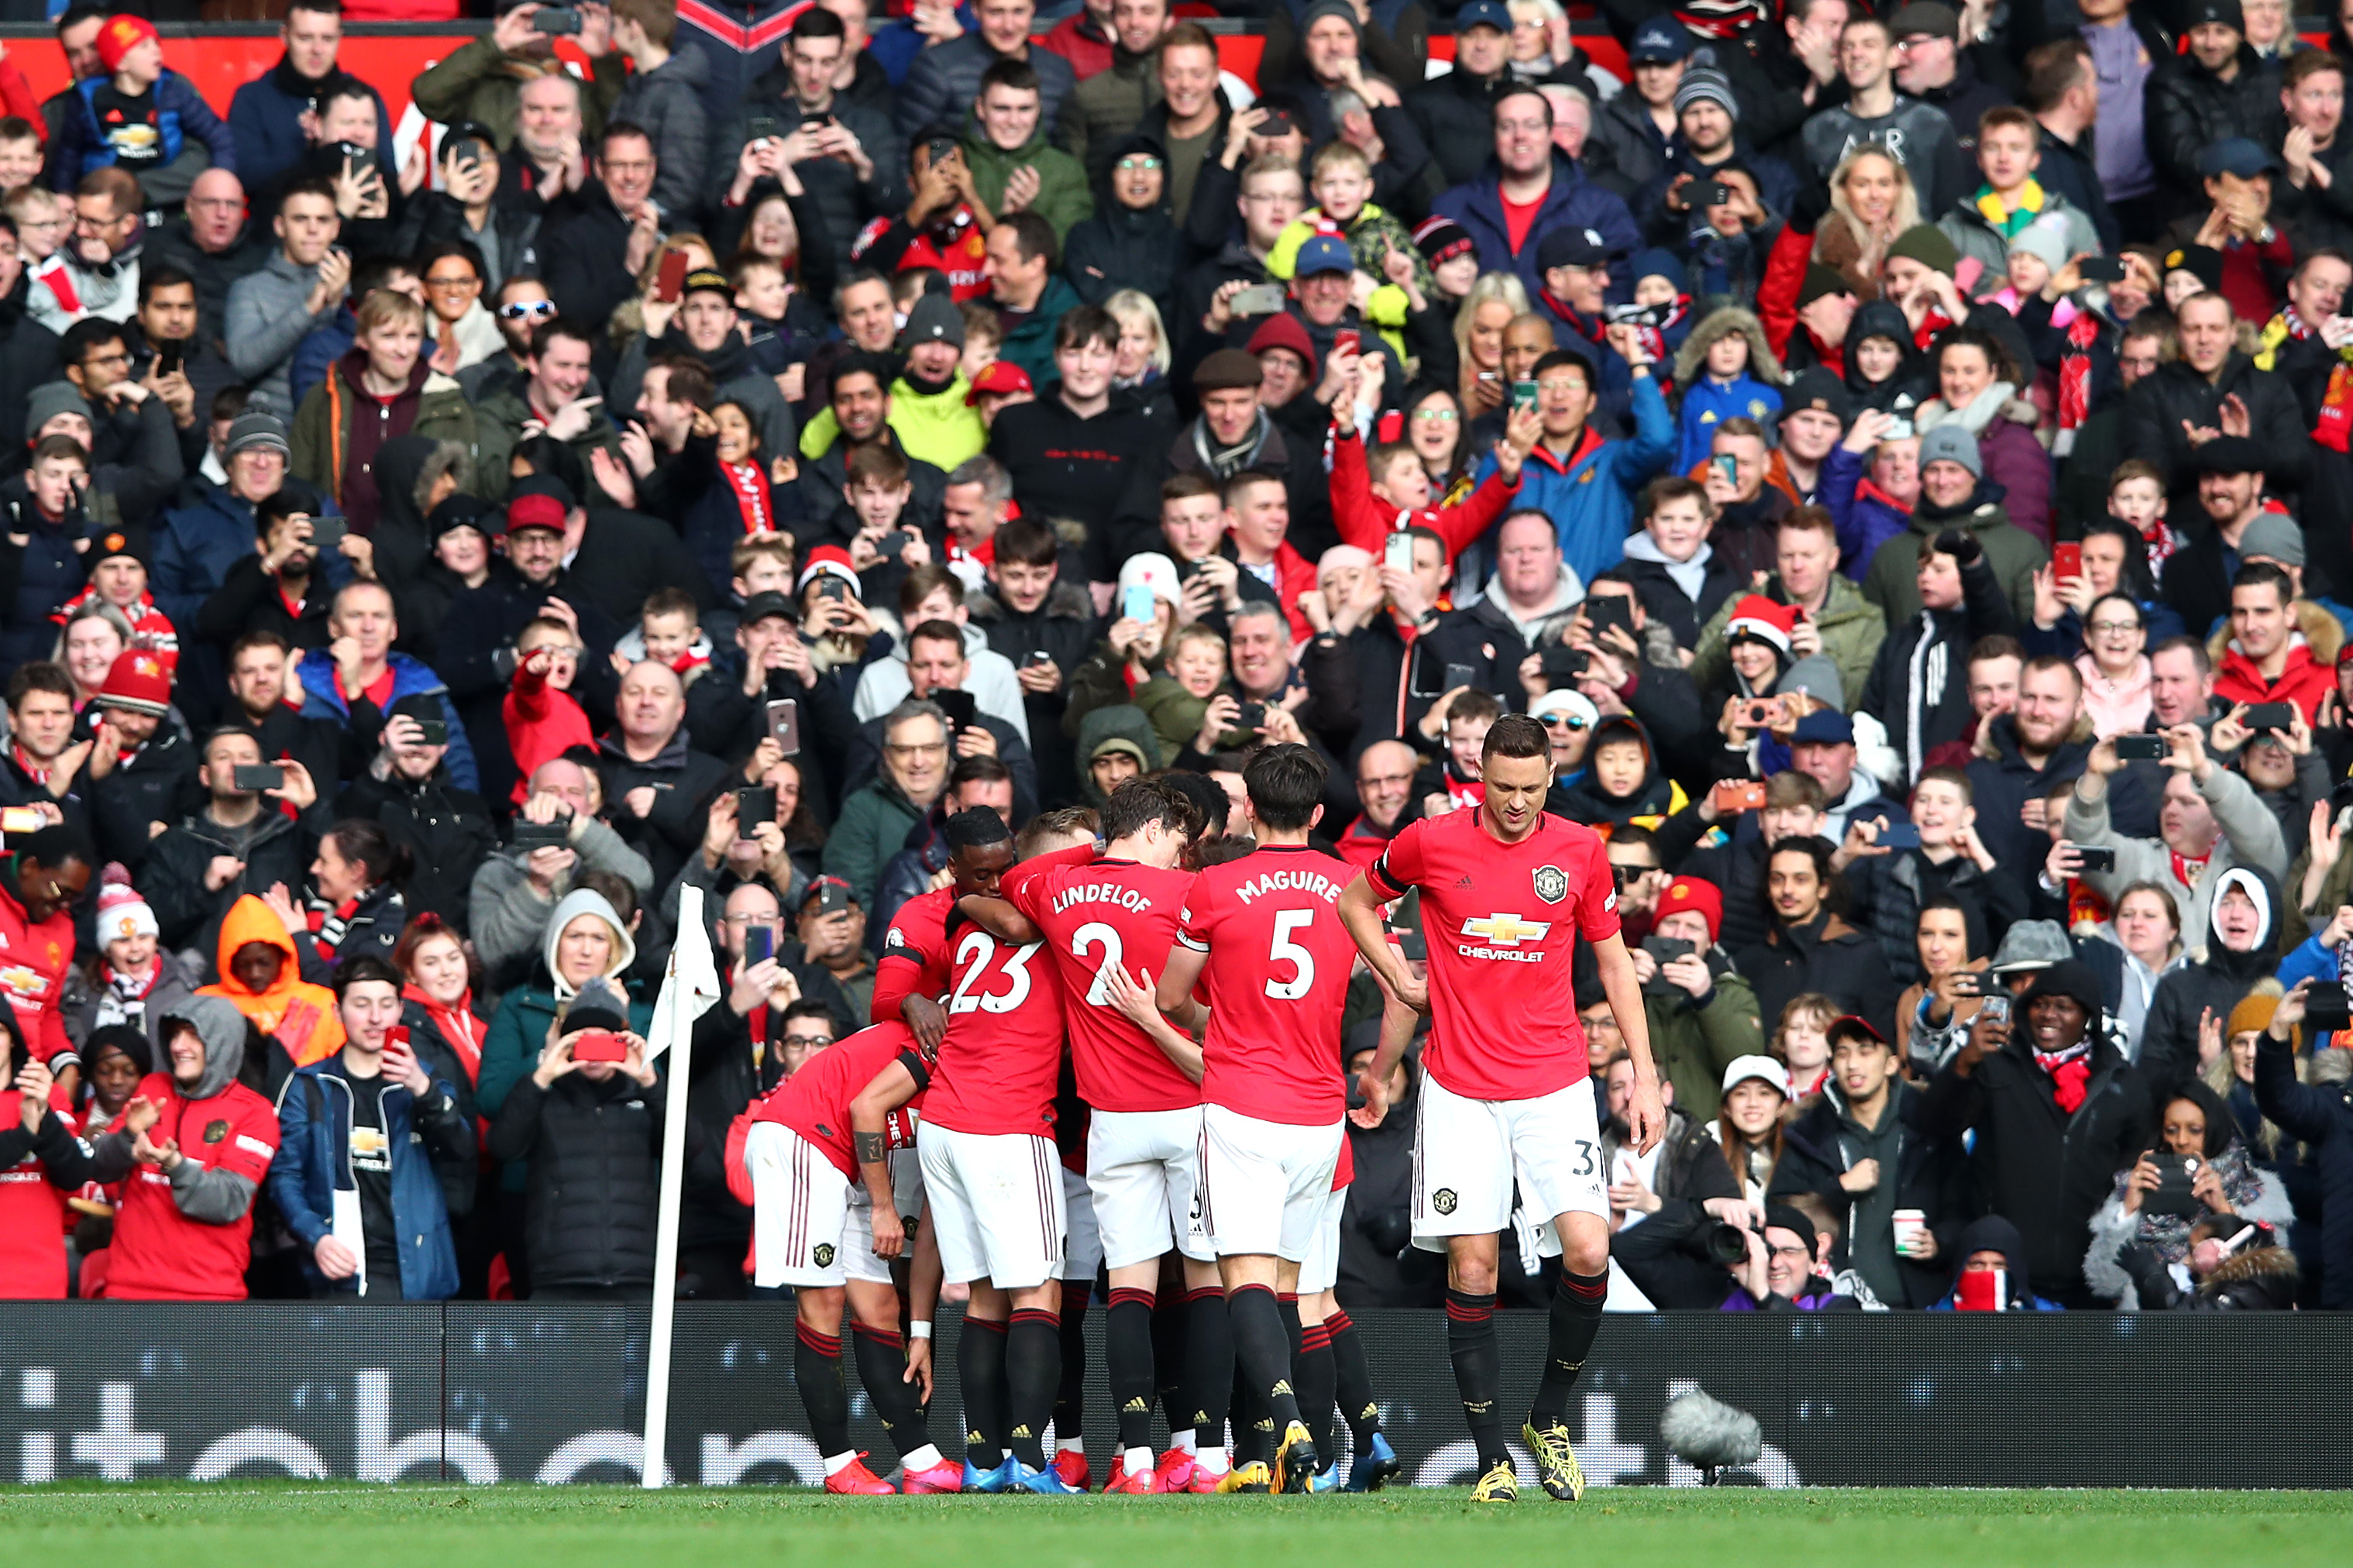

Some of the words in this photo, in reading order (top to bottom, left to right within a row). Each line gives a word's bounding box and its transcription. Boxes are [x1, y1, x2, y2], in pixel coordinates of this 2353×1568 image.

[1839, 129, 1906, 166] AR
[1052, 882, 1152, 914] LINDELOF
[1235, 870, 1343, 905] MAGUIRE
[1072, 921, 1123, 1006] 2
[1264, 908, 1316, 1000] 5
[1458, 944, 1546, 962] CHEVROLET
[949, 931, 1046, 1013] 23
